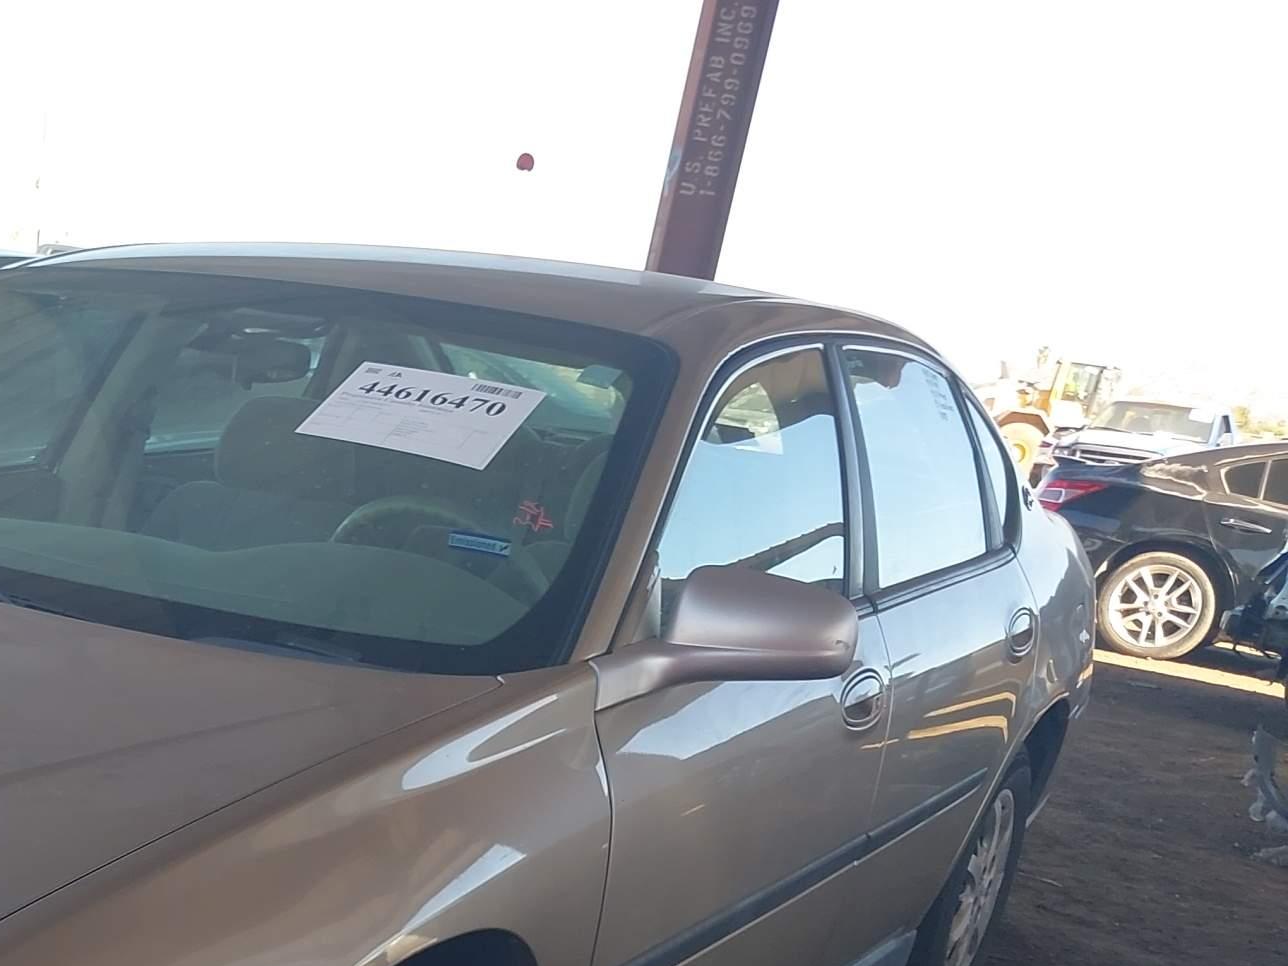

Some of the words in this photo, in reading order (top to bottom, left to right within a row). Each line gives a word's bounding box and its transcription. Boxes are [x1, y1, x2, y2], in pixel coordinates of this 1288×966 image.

[680, 155, 705, 196] U.S.
[693, 55, 725, 142] PREFAB
[715, 1, 740, 43] INC.
[699, 4, 758, 196] 1-866-799-0969
[359, 381, 507, 417] 44616470
